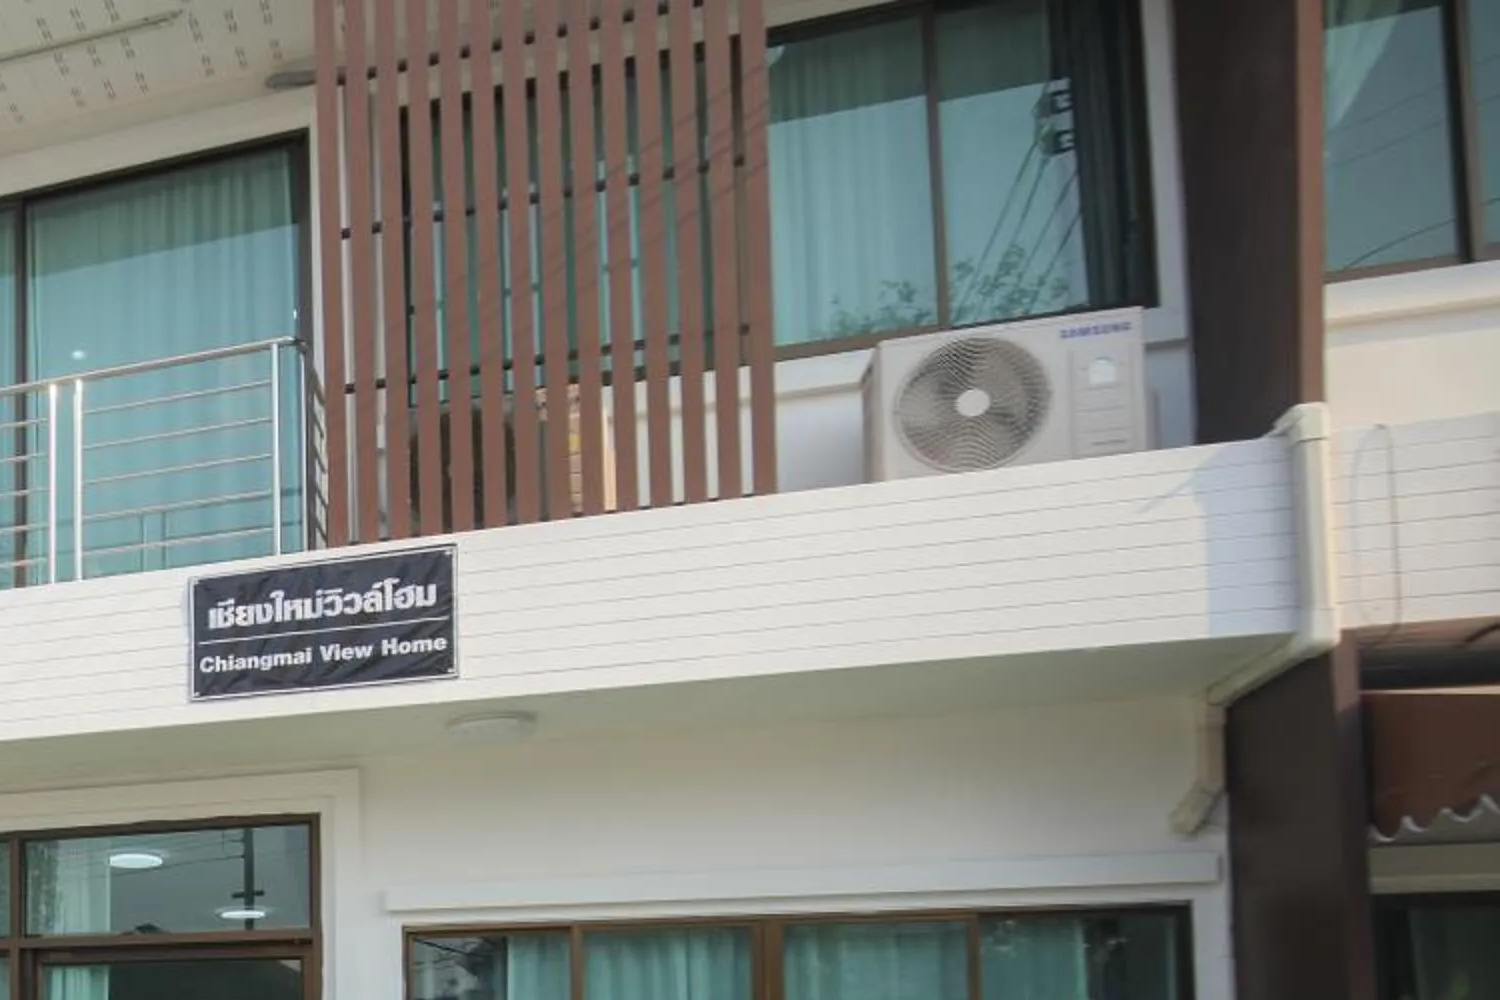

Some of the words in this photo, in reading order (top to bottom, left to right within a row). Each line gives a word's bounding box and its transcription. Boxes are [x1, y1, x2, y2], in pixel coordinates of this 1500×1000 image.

[199, 647, 313, 673] Chiangmai
[319, 643, 373, 662] View
[381, 636, 448, 656] Home
